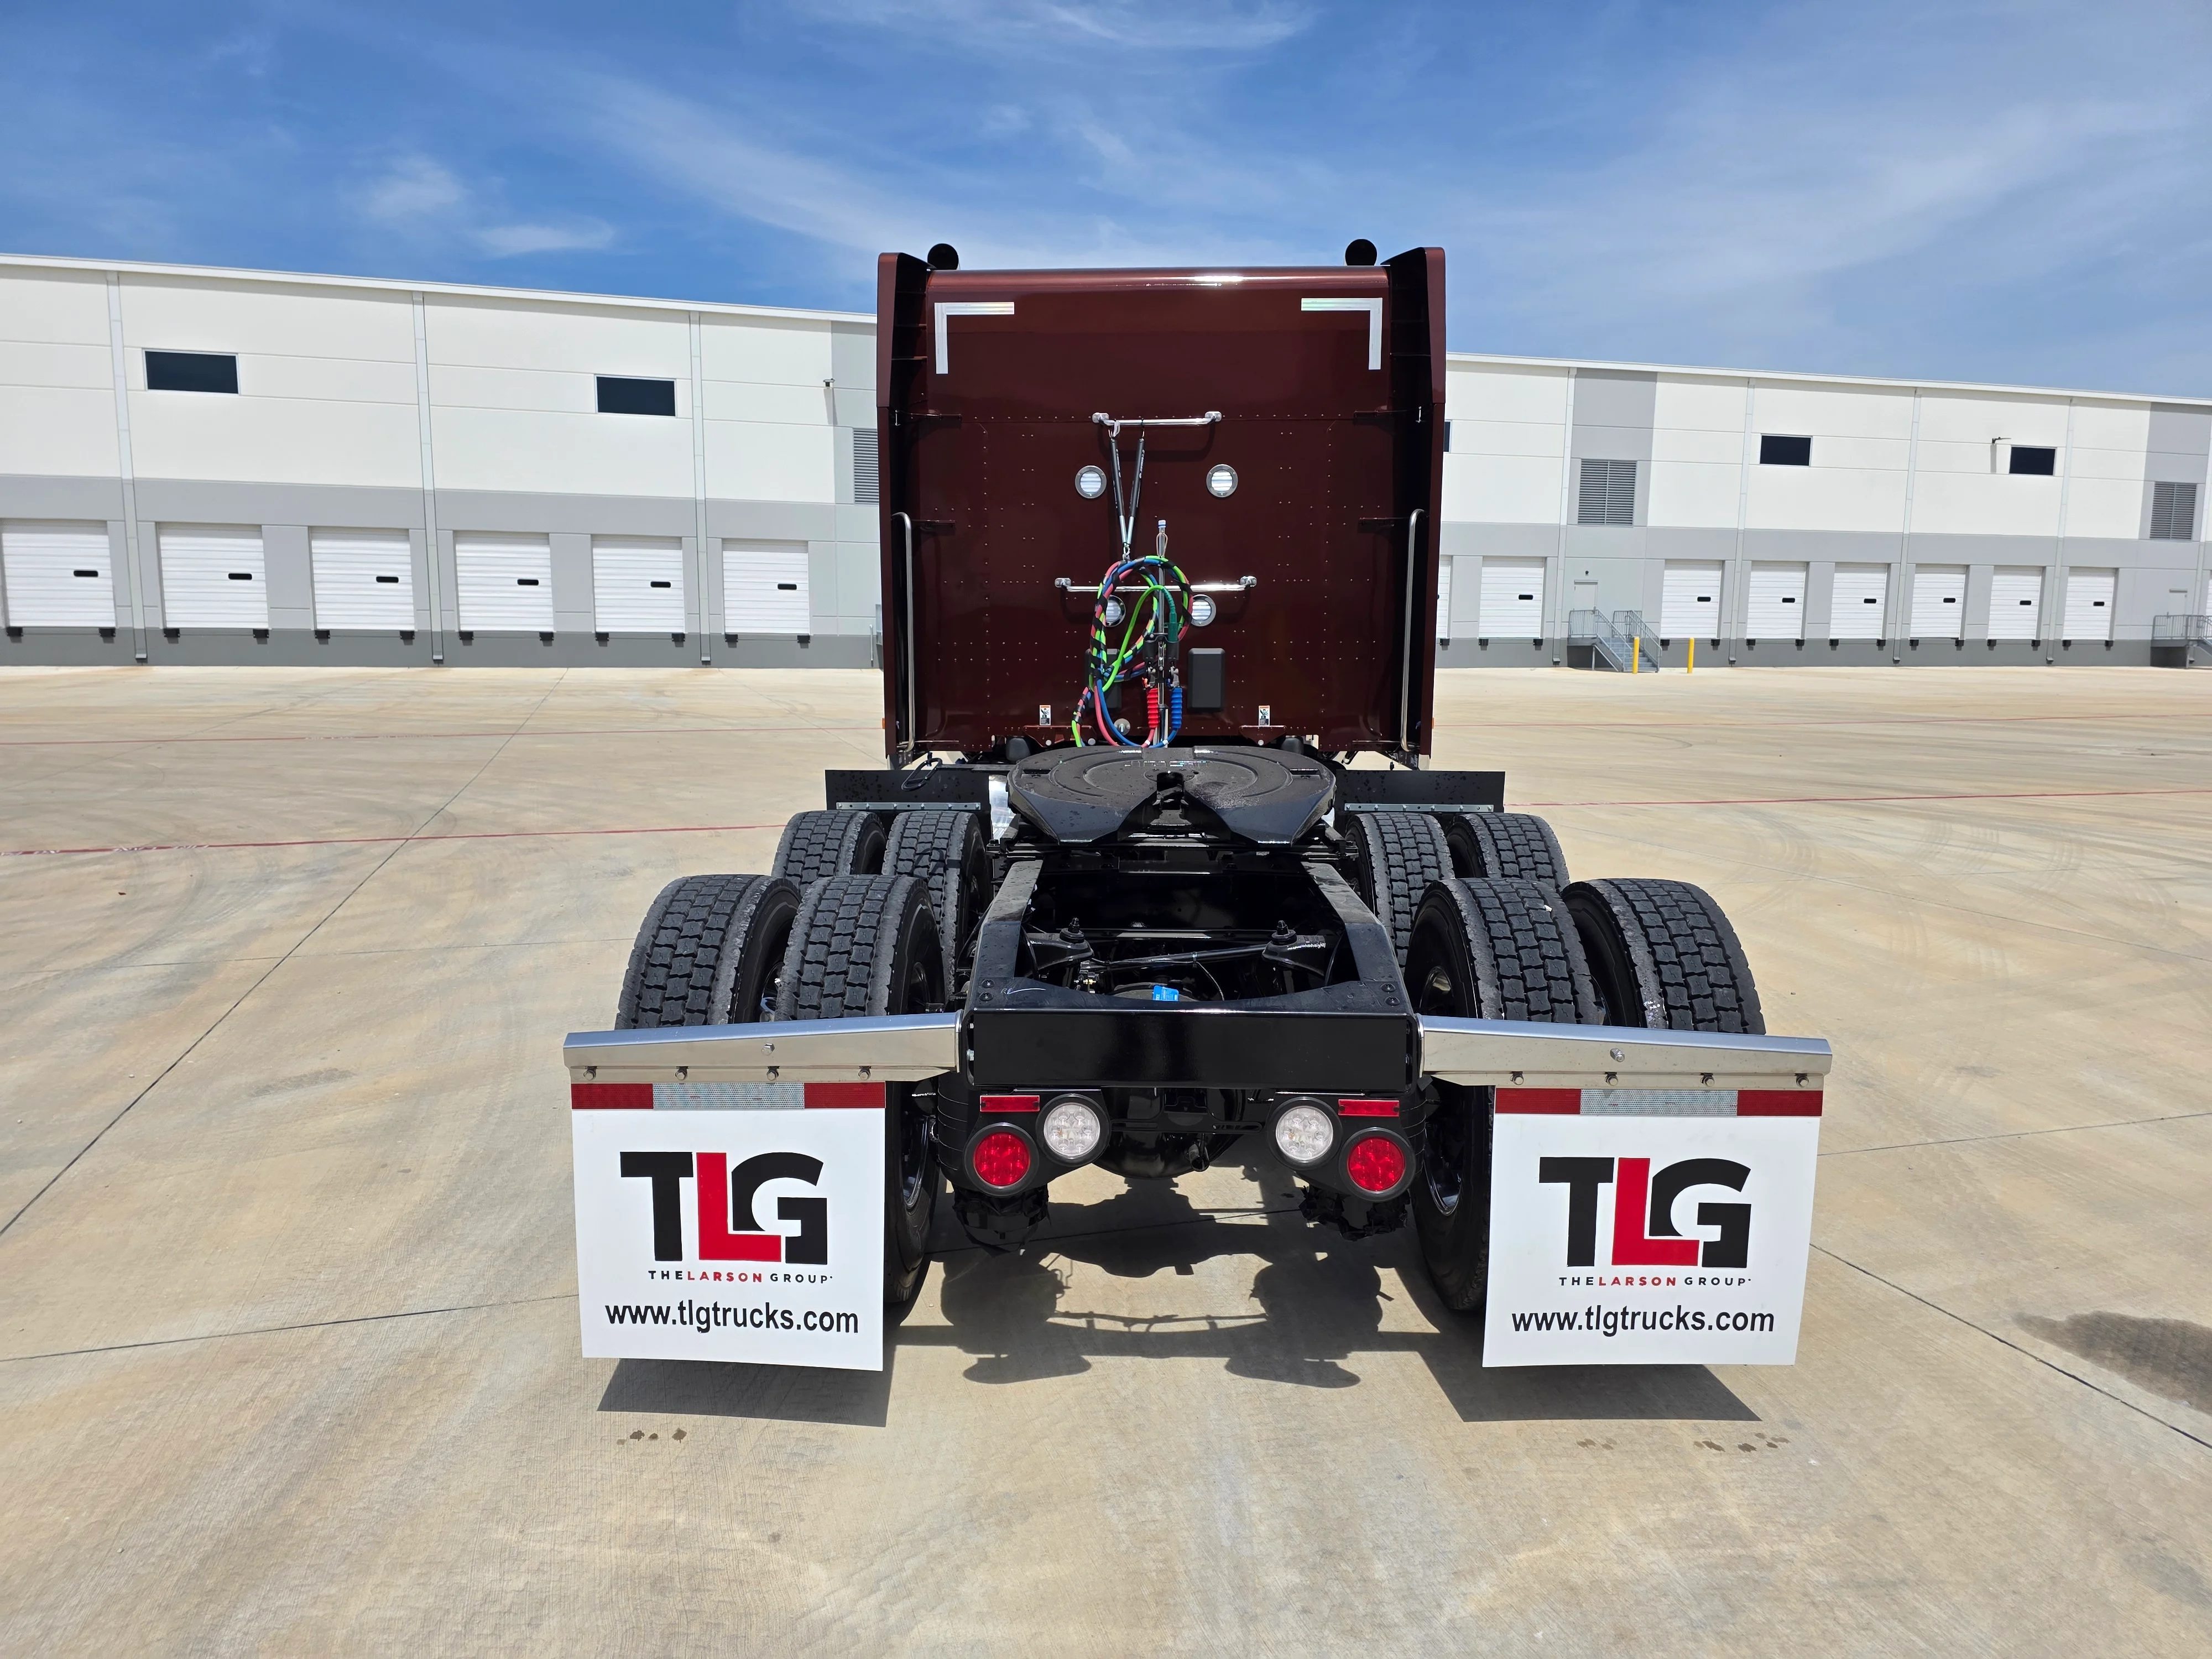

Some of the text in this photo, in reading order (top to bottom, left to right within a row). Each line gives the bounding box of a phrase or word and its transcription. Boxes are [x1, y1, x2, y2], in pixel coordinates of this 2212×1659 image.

[620, 1151, 828, 1265] TLG
[1538, 1156, 1752, 1269] TLG
[770, 1273, 828, 1284] GROUP
[1684, 1277, 1746, 1286] GROUP
[604, 1299, 858, 1334] www.tlgtrucks.com
[1511, 1305, 1775, 1337] www.tlgtrucks.com
